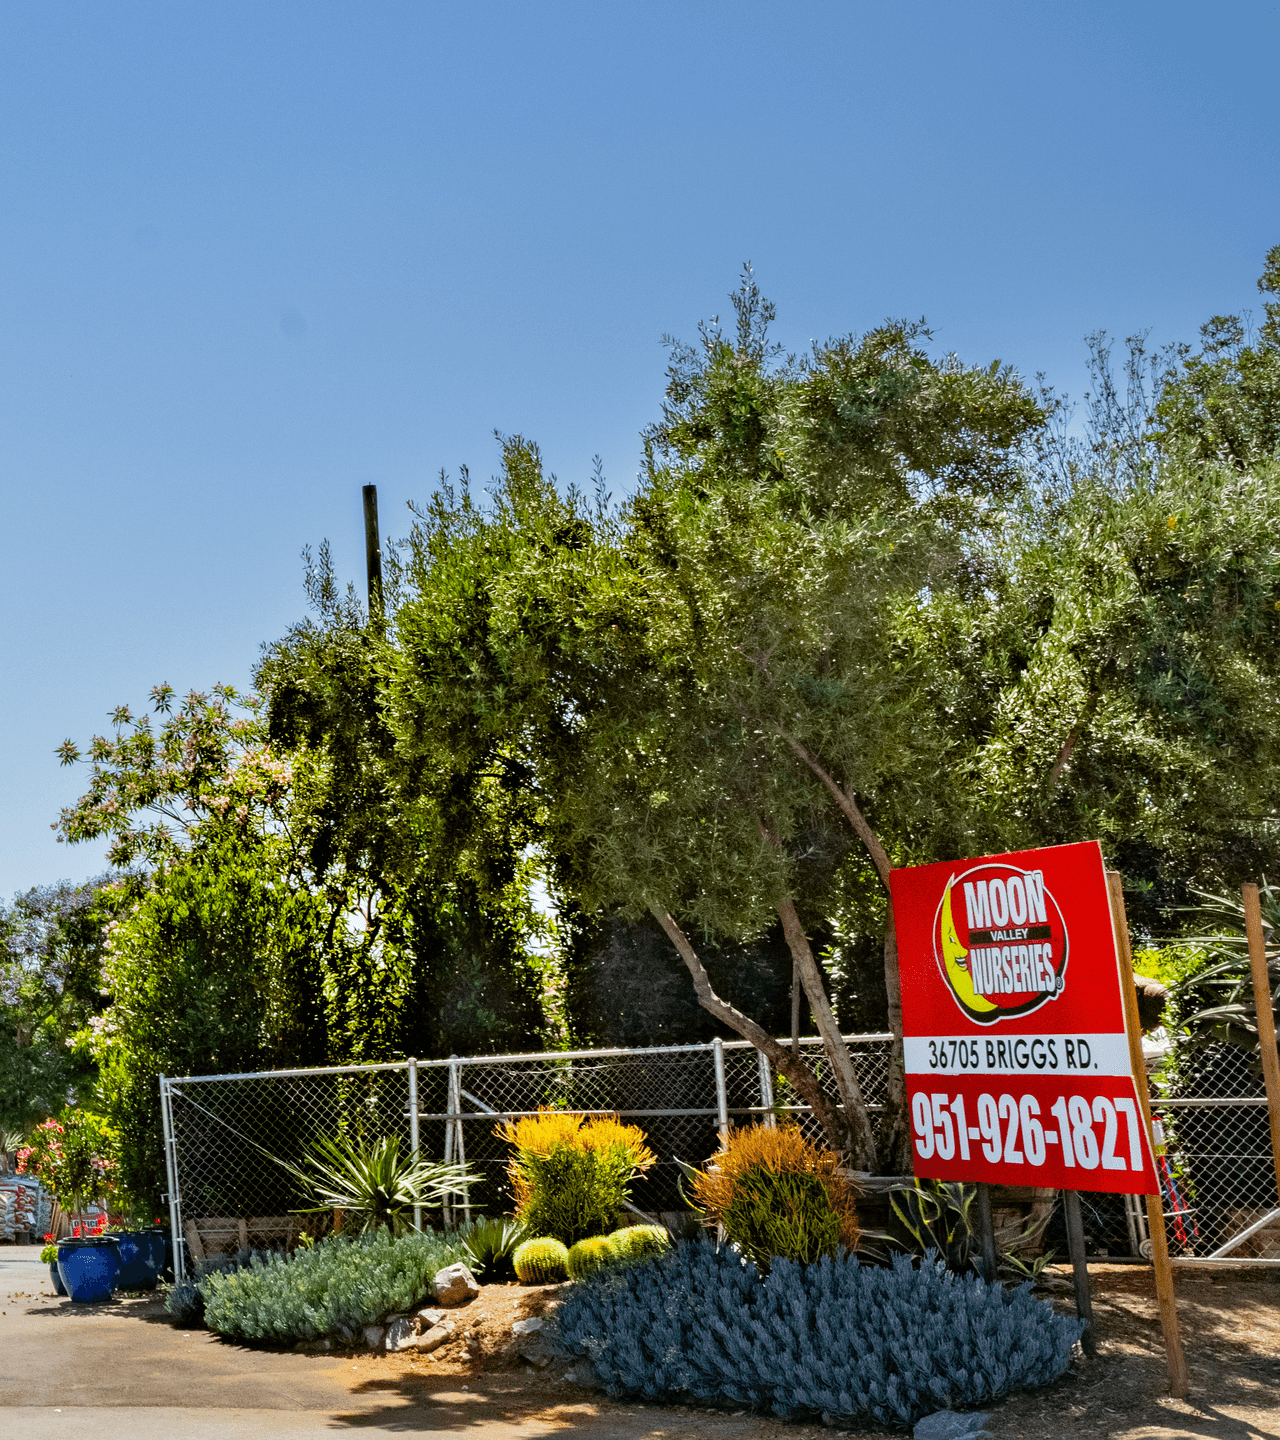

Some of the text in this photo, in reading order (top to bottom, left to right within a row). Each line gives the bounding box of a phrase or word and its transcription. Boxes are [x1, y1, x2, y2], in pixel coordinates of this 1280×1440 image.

[963, 871, 1048, 929] MOON
[990, 928, 1029, 942] VALLEY
[970, 943, 1057, 996] NURSERIES
[928, 1038, 1099, 1070] 36705 BRIGGS RD.
[912, 1091, 1144, 1172] 951-926-1827
